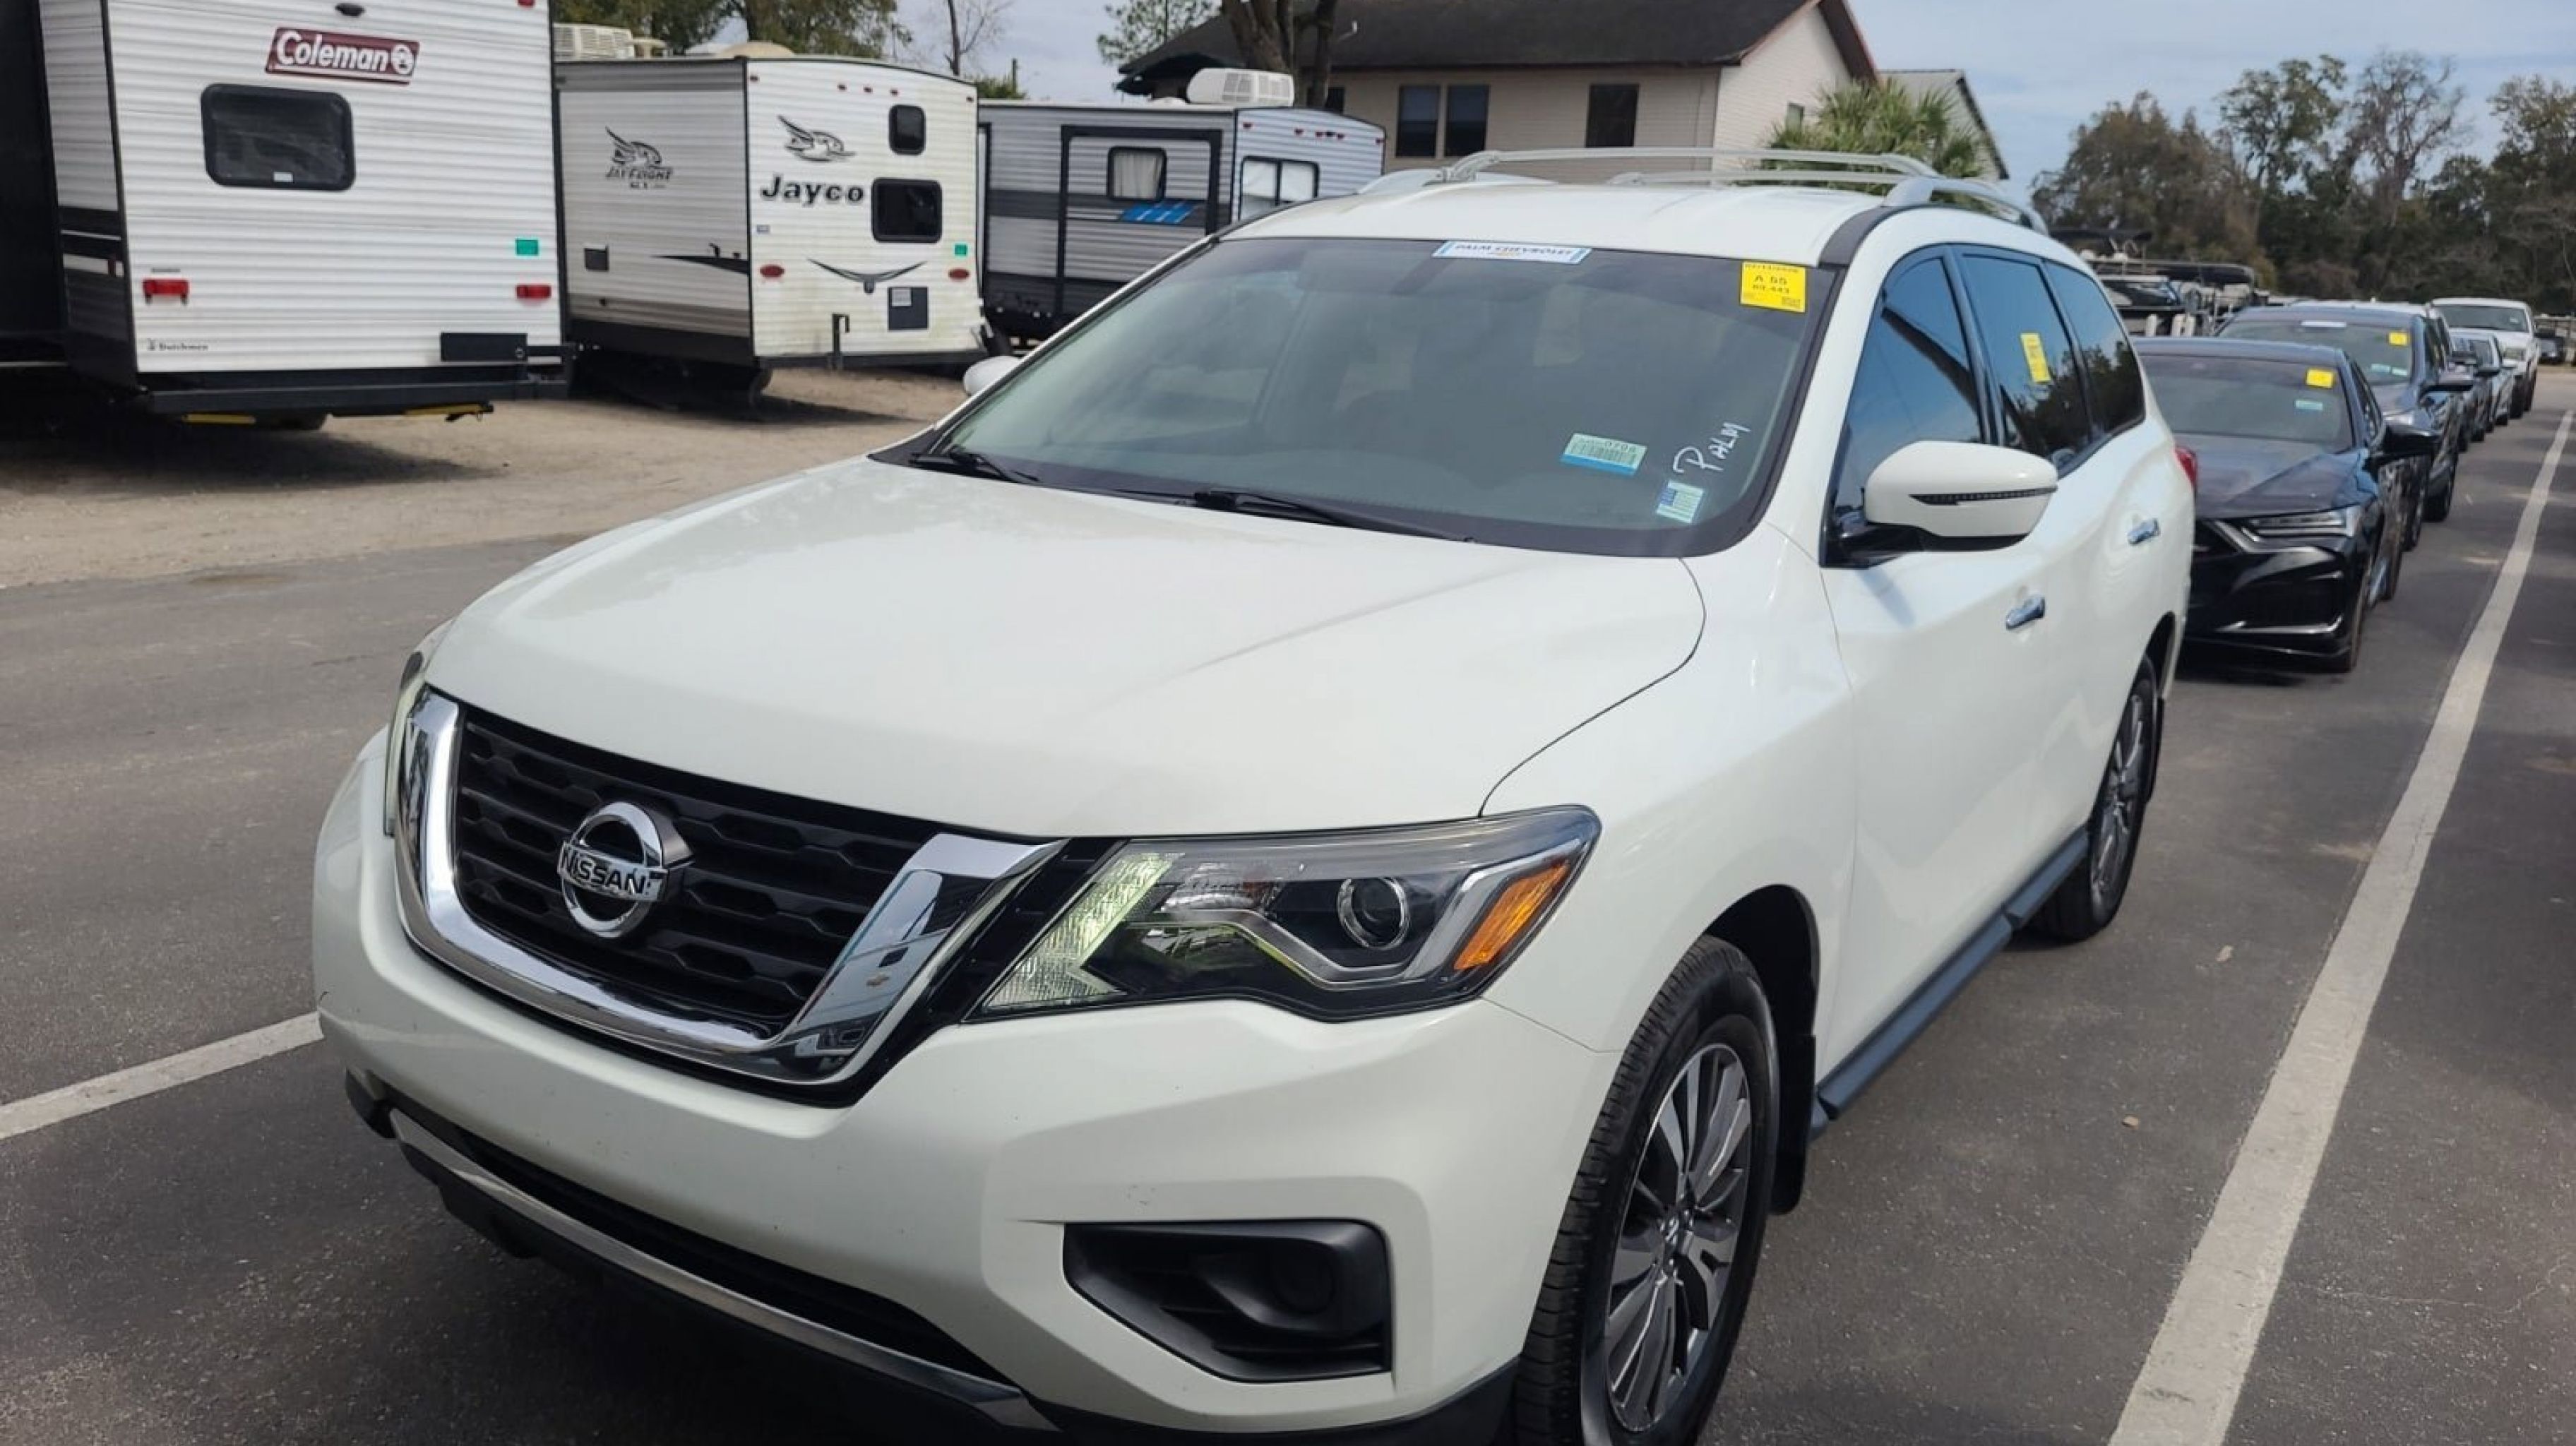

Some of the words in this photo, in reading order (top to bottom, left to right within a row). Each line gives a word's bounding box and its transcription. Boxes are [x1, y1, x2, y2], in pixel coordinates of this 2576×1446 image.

[276, 30, 388, 71] Coleman
[761, 173, 864, 208] Jayco
[566, 847, 647, 895] NISSAN
